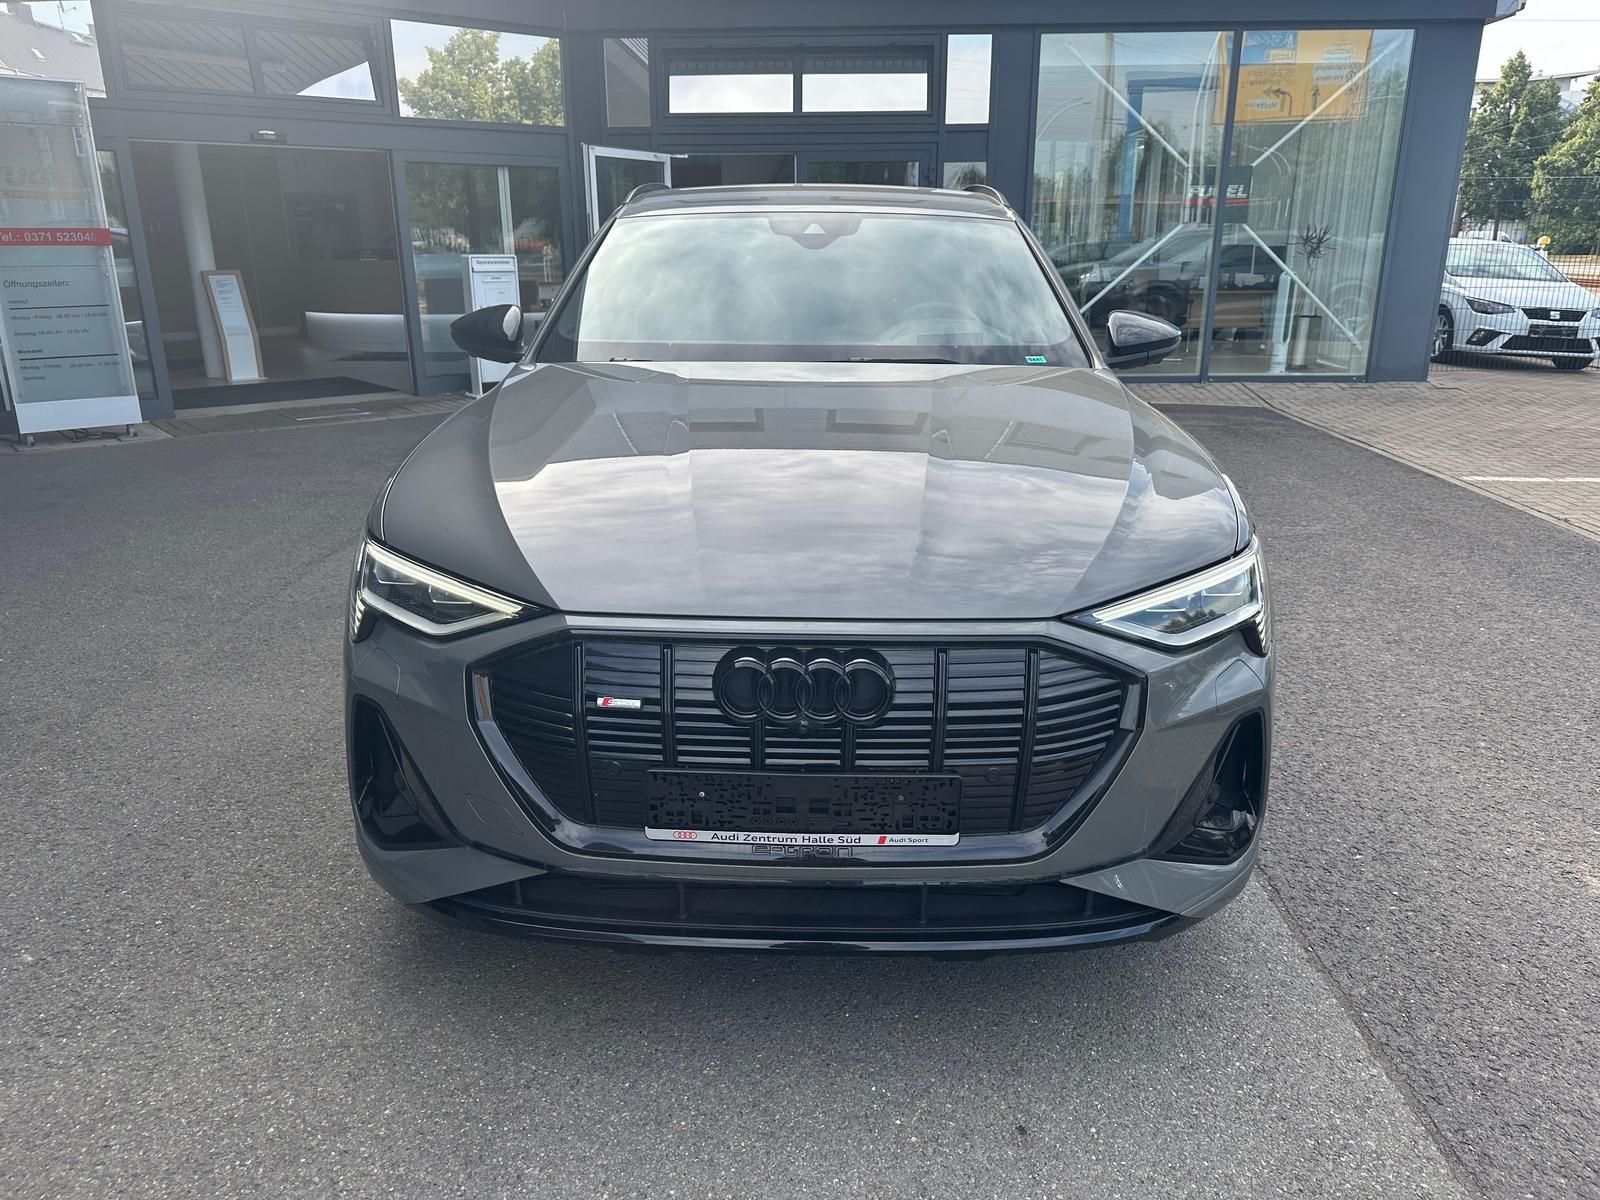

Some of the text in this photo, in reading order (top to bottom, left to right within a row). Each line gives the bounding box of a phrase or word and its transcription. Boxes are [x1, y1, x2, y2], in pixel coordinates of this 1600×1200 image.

[24, 231, 52, 242] 0371
[3, 279, 71, 289] Öffnungszeiten:
[711, 832, 861, 844] Audi Zentrum Halle Süd
